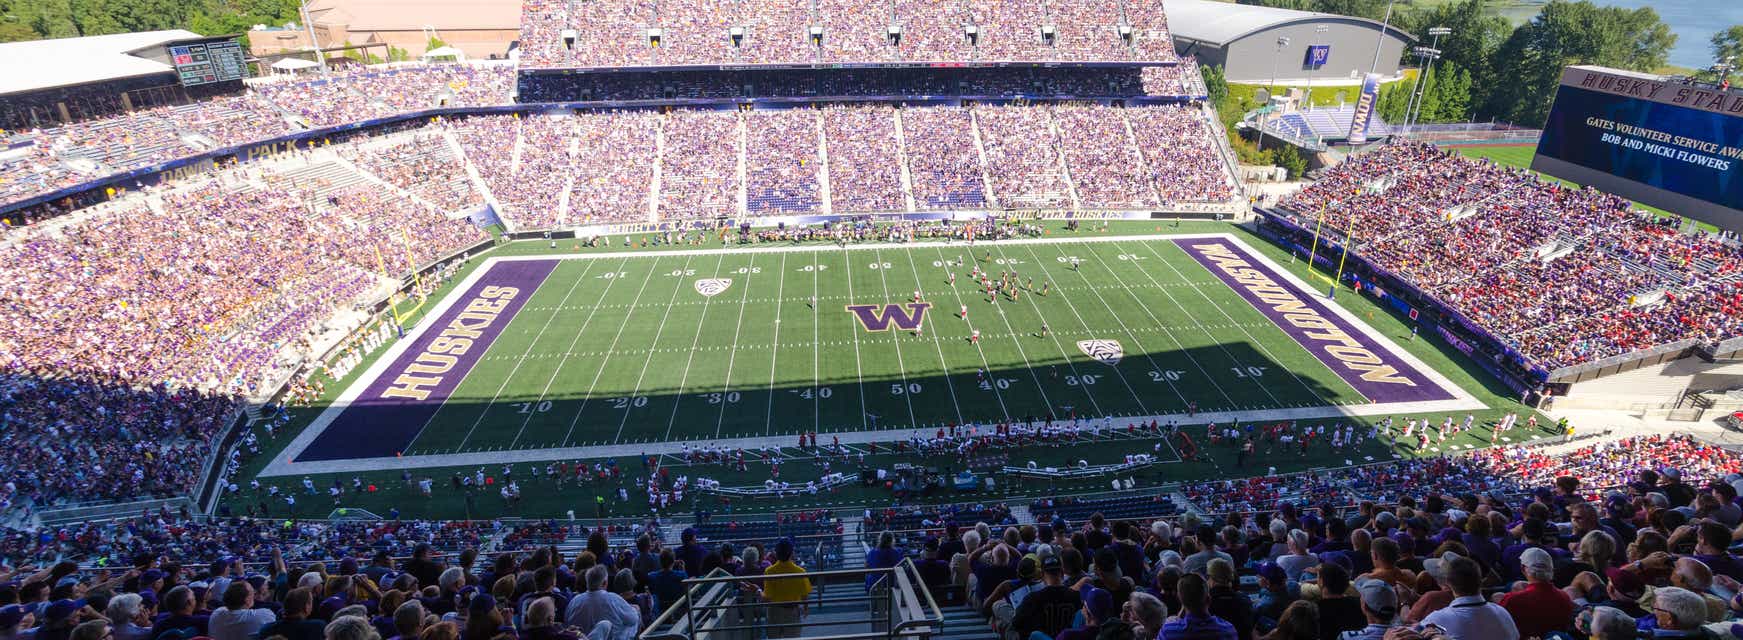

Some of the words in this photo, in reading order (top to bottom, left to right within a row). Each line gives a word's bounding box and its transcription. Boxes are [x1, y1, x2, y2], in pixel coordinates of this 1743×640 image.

[1312, 48, 1328, 61] W
[1582, 73, 1663, 99] HUSKY
[1586, 117, 1615, 130] GATES
[1616, 122, 1672, 144] VOLUNTEER
[1672, 135, 1719, 154] SERVICE
[247, 138, 301, 160] PACK
[1601, 132, 1621, 145] BOB
[1622, 137, 1644, 150] AND
[1644, 143, 1676, 158] MICKI
[1676, 150, 1731, 171] FLOWERS
[844, 301, 933, 333] W
[1192, 243, 1417, 387] WASHINGTON
[381, 285, 520, 401] HUSKIES
[1148, 370, 1181, 382] 20
[1232, 366, 1263, 378] 10
[1064, 374, 1096, 386] 30
[800, 387, 833, 399] 40
[891, 382, 922, 395] 50
[613, 396, 648, 409] 20
[708, 391, 741, 404] 30
[516, 400, 552, 413] 10
